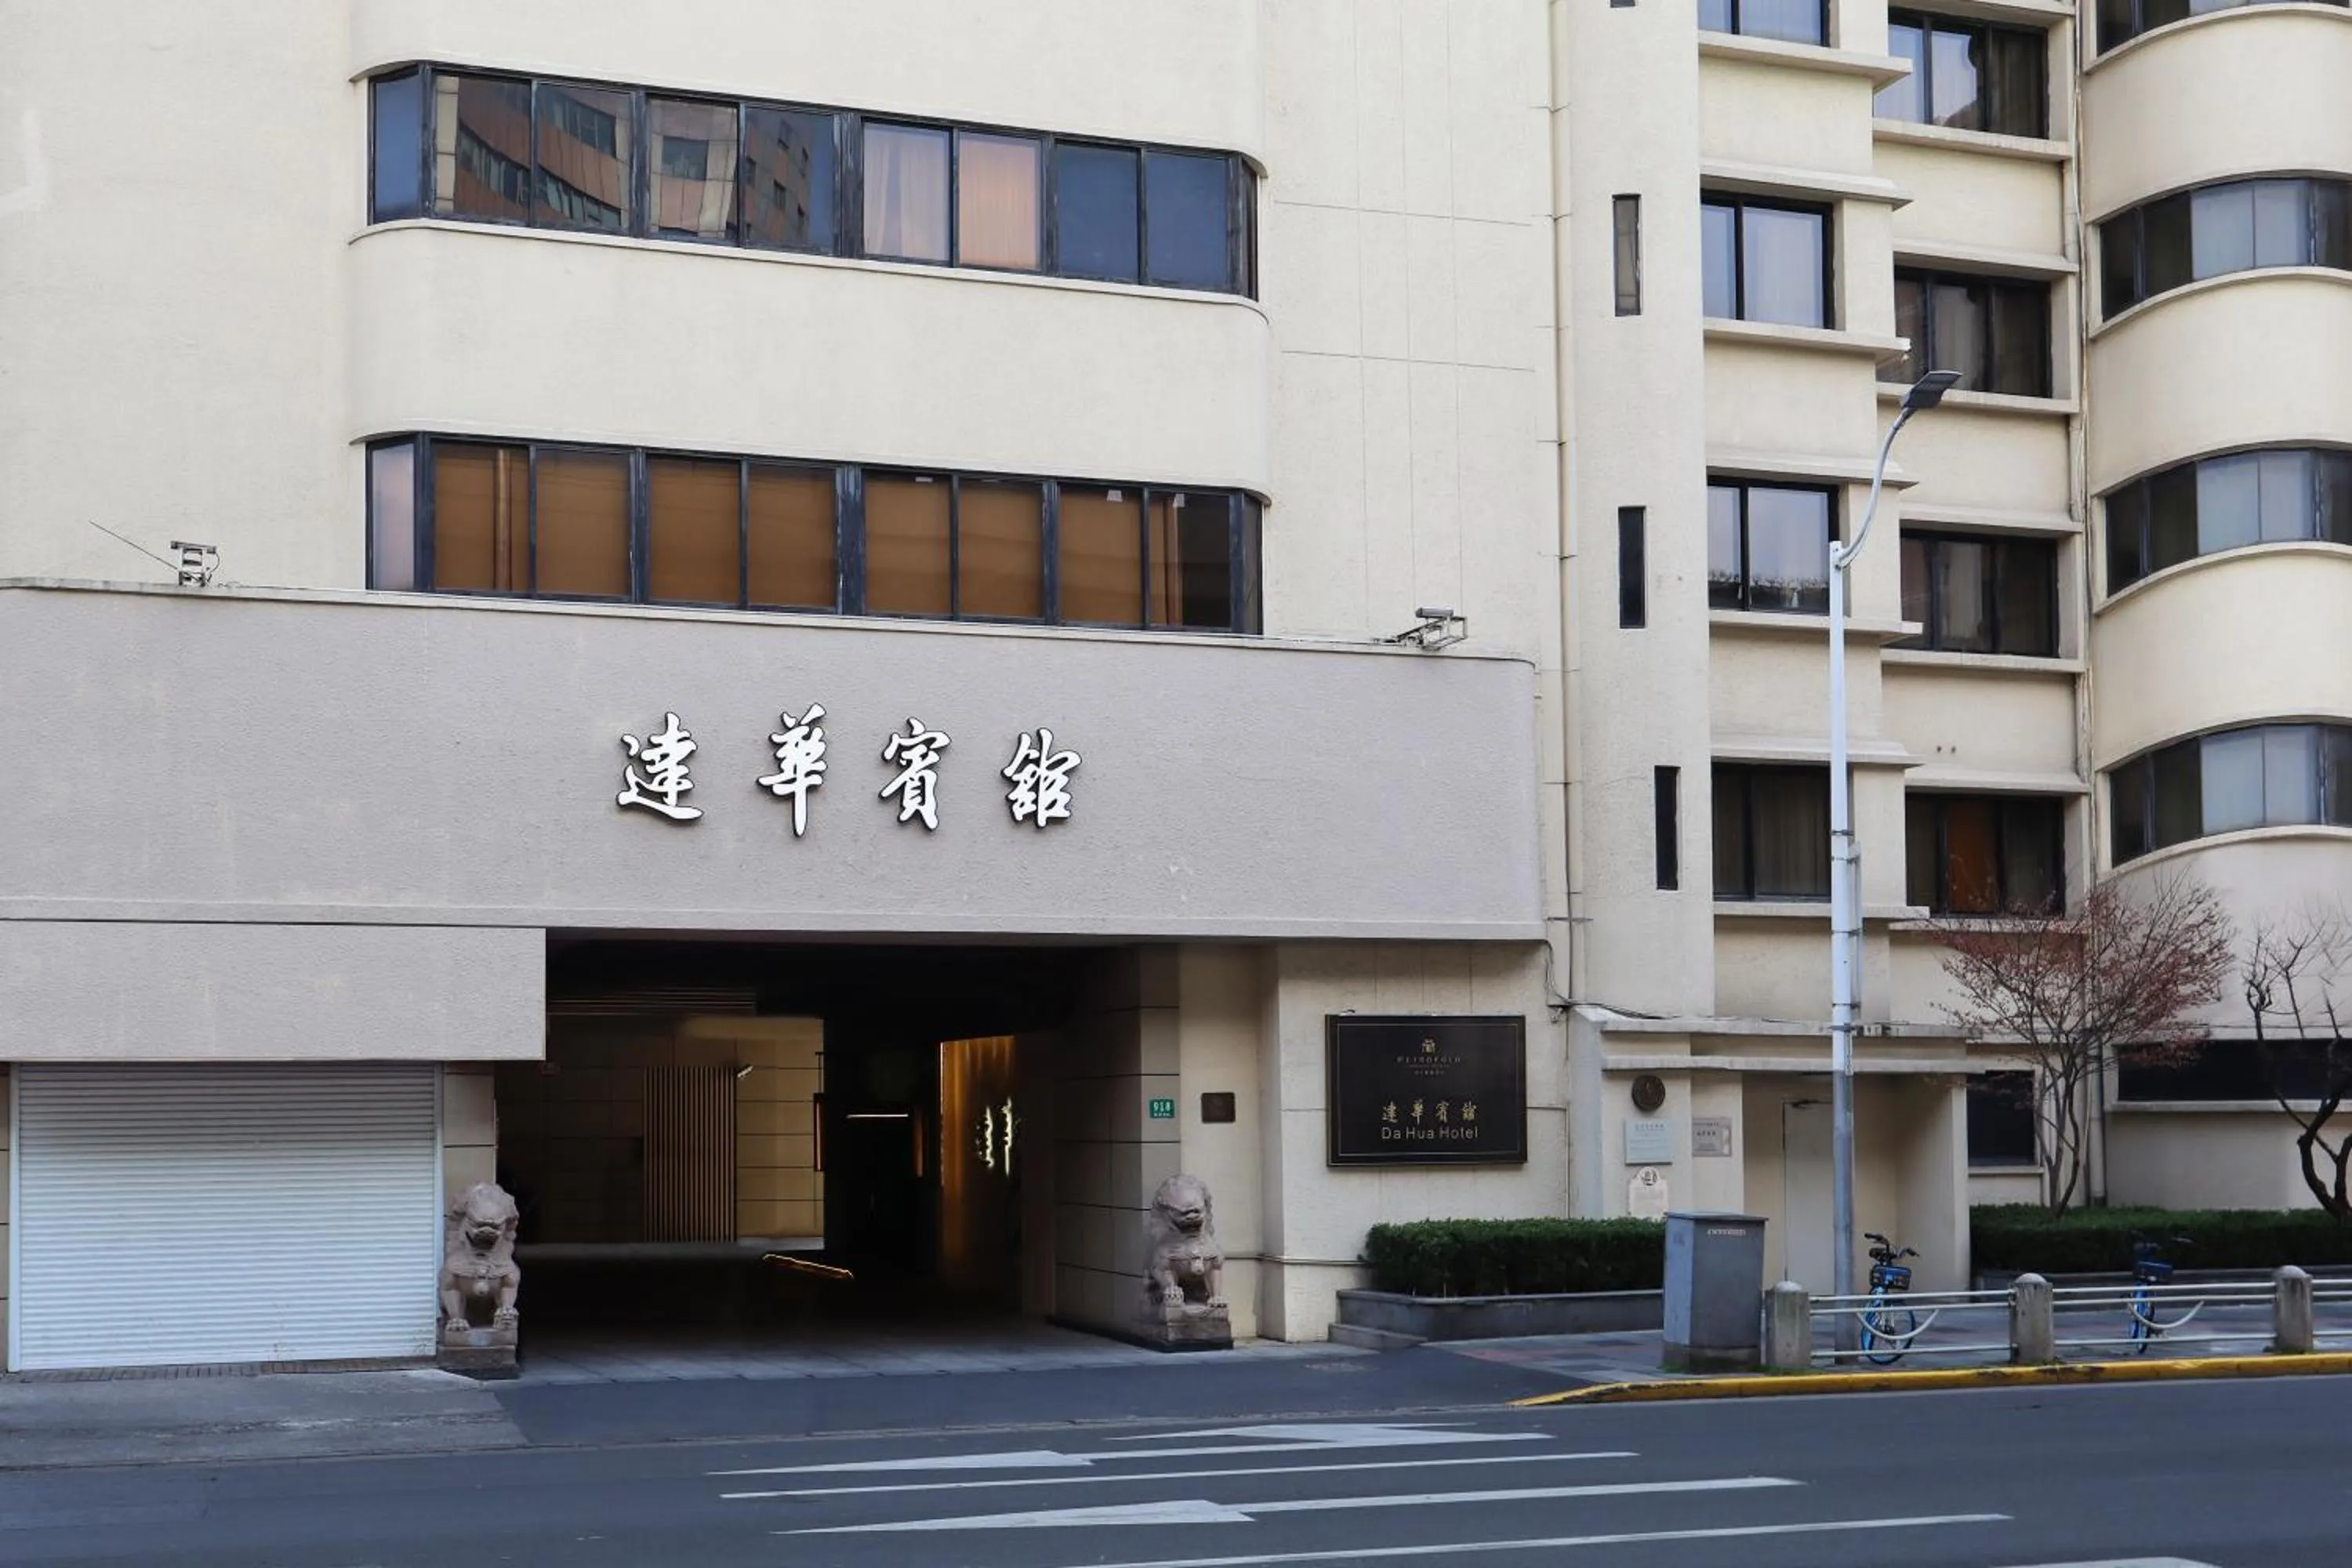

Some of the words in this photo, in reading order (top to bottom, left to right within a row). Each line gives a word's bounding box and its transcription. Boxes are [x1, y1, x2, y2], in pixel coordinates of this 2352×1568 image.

[1381, 1127, 1401, 1139] Da
[1406, 1127, 1435, 1139] Hua
[1439, 1126, 1479, 1139] Hotel
